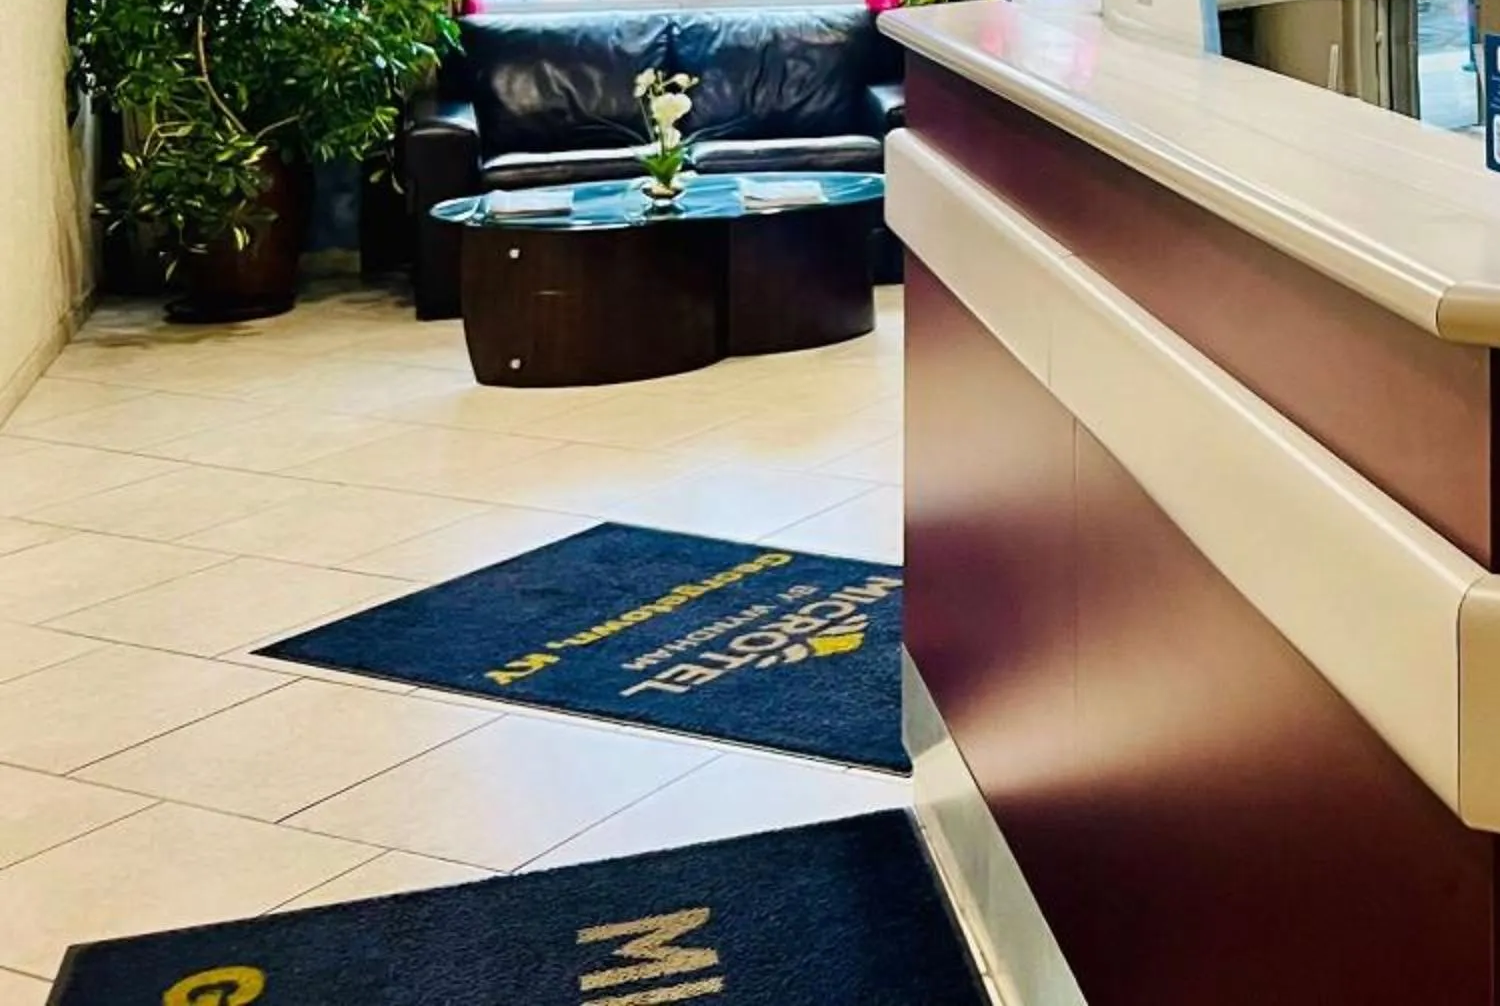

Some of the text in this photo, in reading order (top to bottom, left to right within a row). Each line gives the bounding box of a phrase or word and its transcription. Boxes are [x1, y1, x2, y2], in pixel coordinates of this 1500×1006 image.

[618, 574, 904, 698] MICROTEL
[620, 583, 823, 672] BY WYNDHAM
